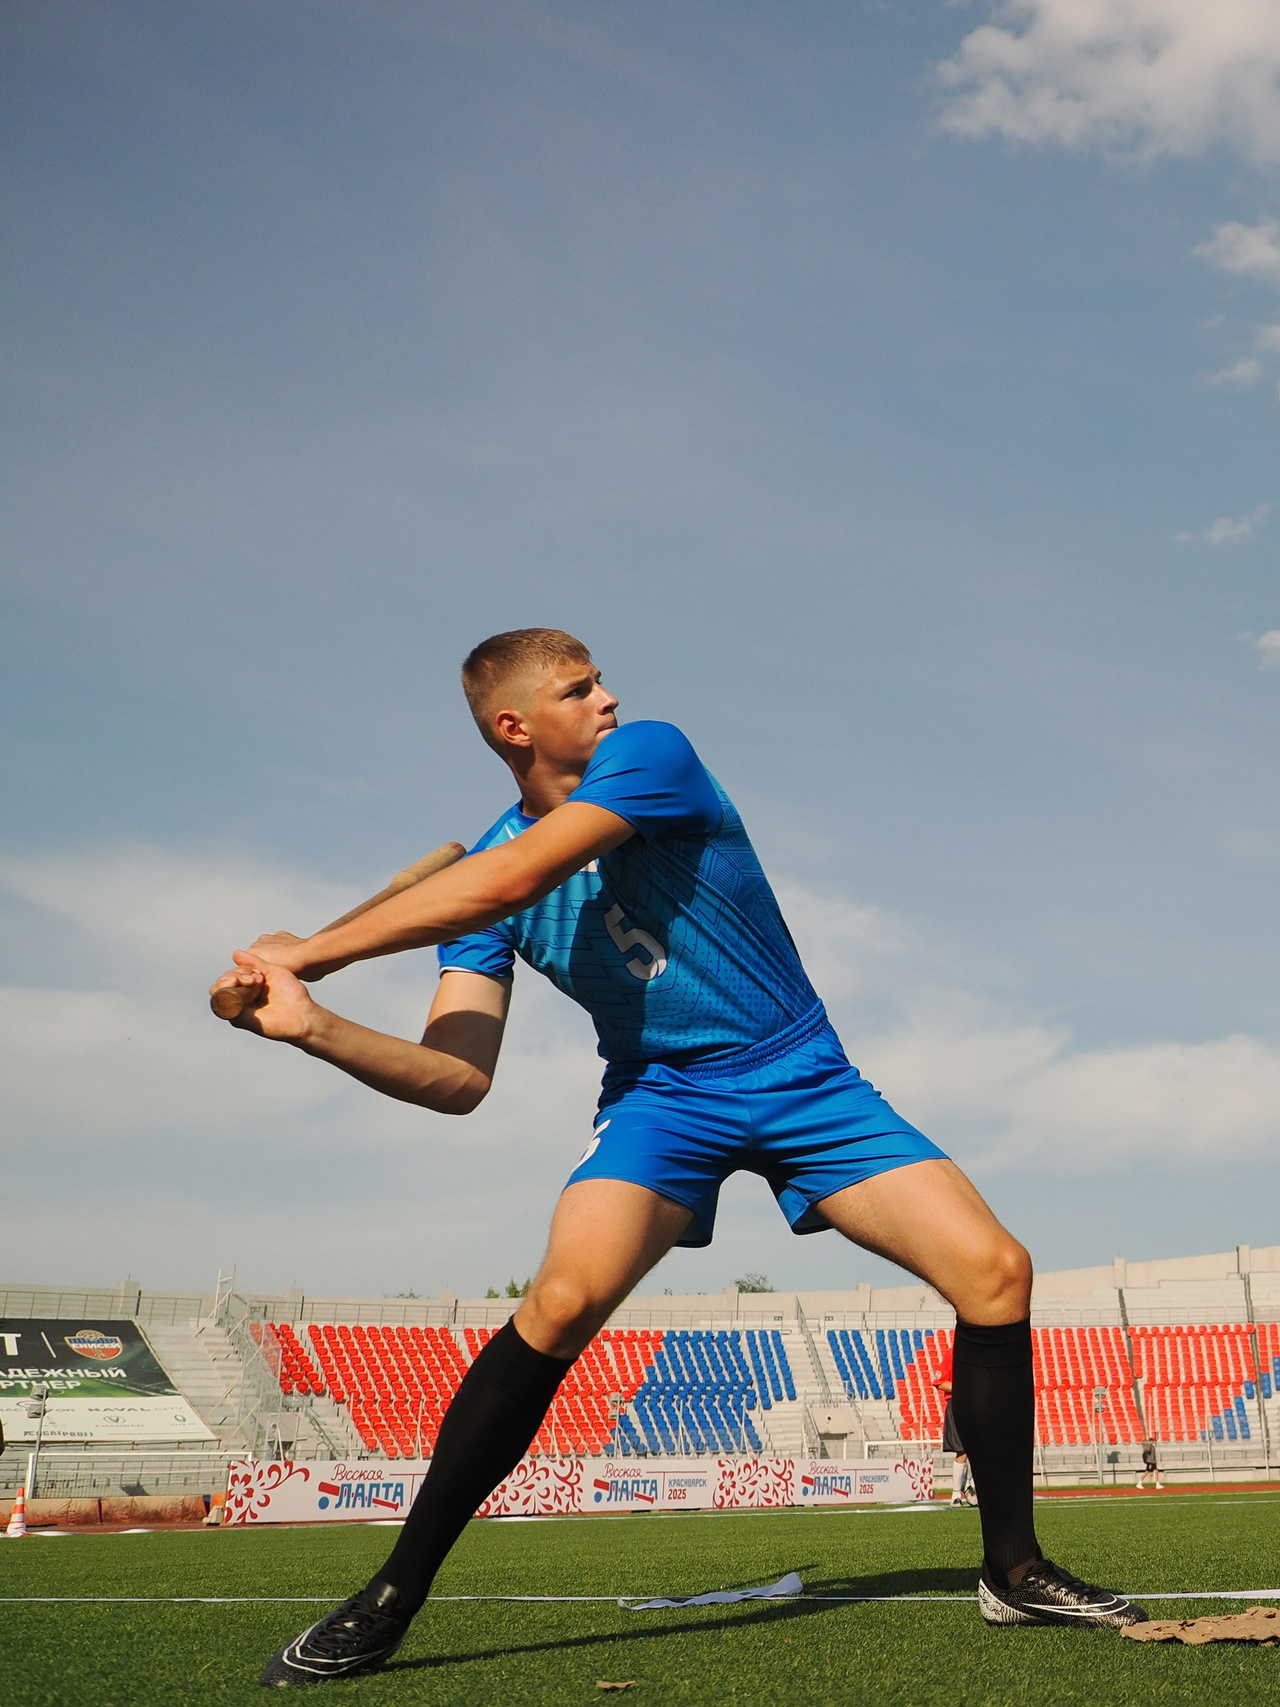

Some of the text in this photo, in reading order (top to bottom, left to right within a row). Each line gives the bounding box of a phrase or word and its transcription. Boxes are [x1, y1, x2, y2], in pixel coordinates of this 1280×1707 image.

[603, 902, 667, 981] 5
[331, 1463, 384, 1481] Русская
[602, 1462, 642, 1478] Русская
[808, 1461, 839, 1475] Русская
[607, 1479, 658, 1502] ЛАПТА
[668, 1478, 707, 1488] КРАСНОЯРСК
[812, 1475, 851, 1496] ЛАПТА
[859, 1484, 874, 1494] 2025
[335, 1482, 404, 1509] ЛАПТА
[668, 1488, 687, 1500] 2025
